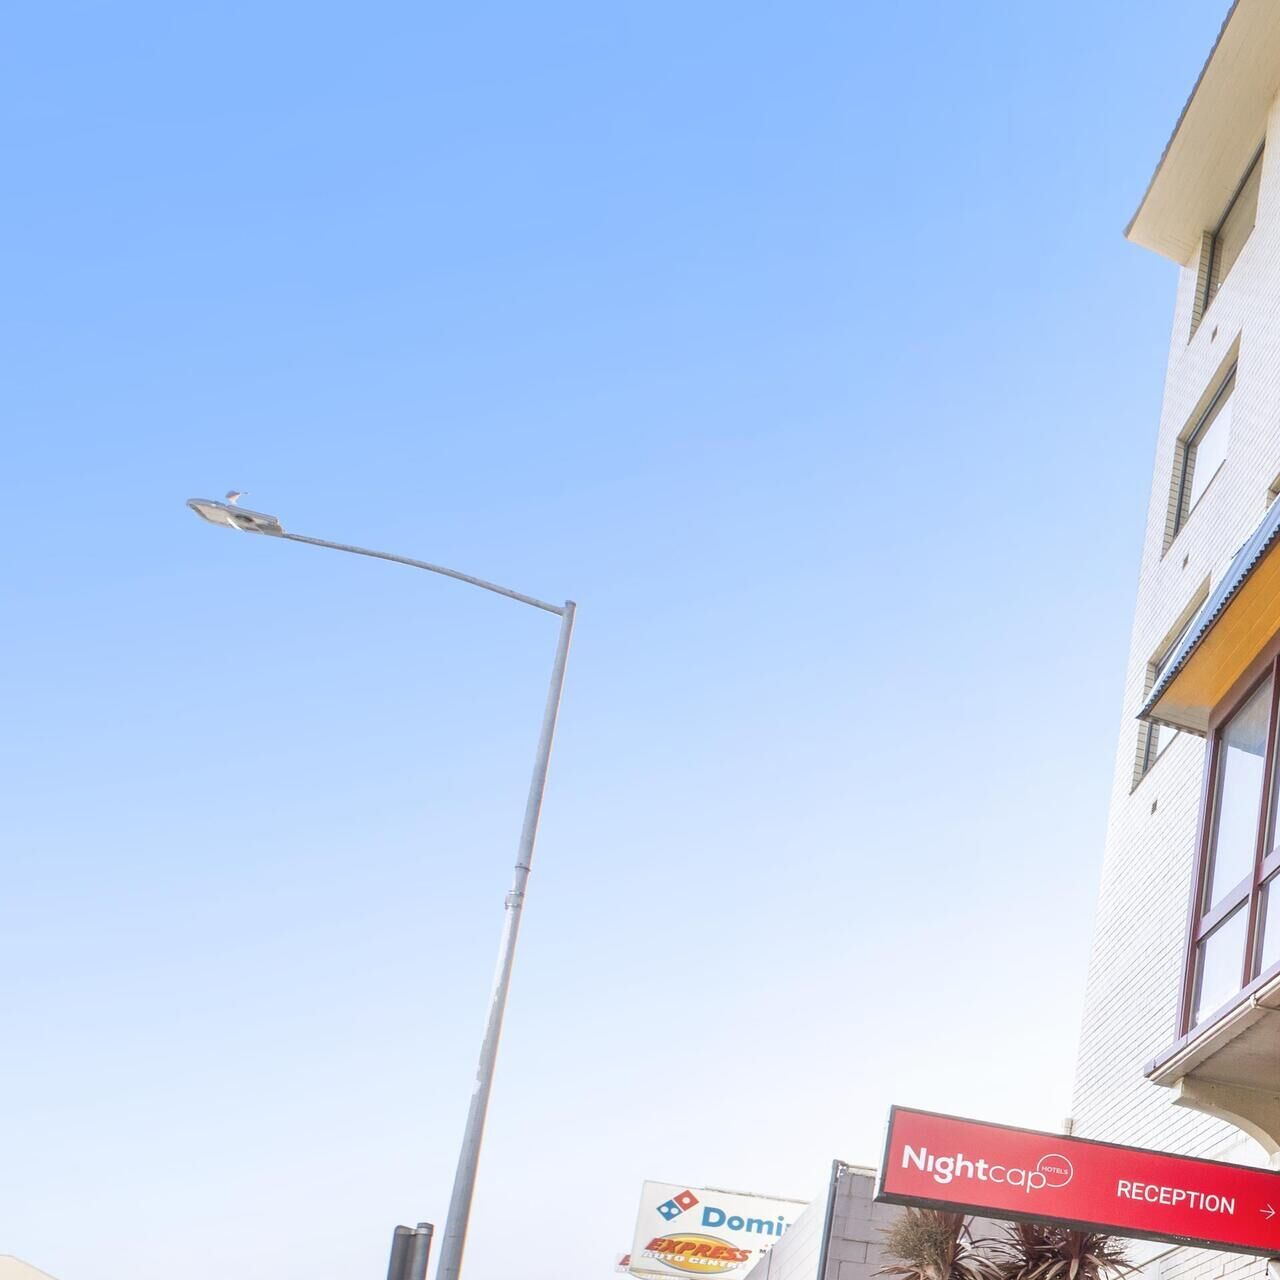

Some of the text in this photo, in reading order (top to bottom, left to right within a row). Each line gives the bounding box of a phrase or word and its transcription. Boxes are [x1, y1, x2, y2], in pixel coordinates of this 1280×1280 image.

[901, 1144, 1047, 1194] Nightcap
[1040, 1164, 1069, 1177] HOTELS
[1117, 1180, 1236, 1215] RECEPTION
[644, 1237, 752, 1263] EXPRESS
